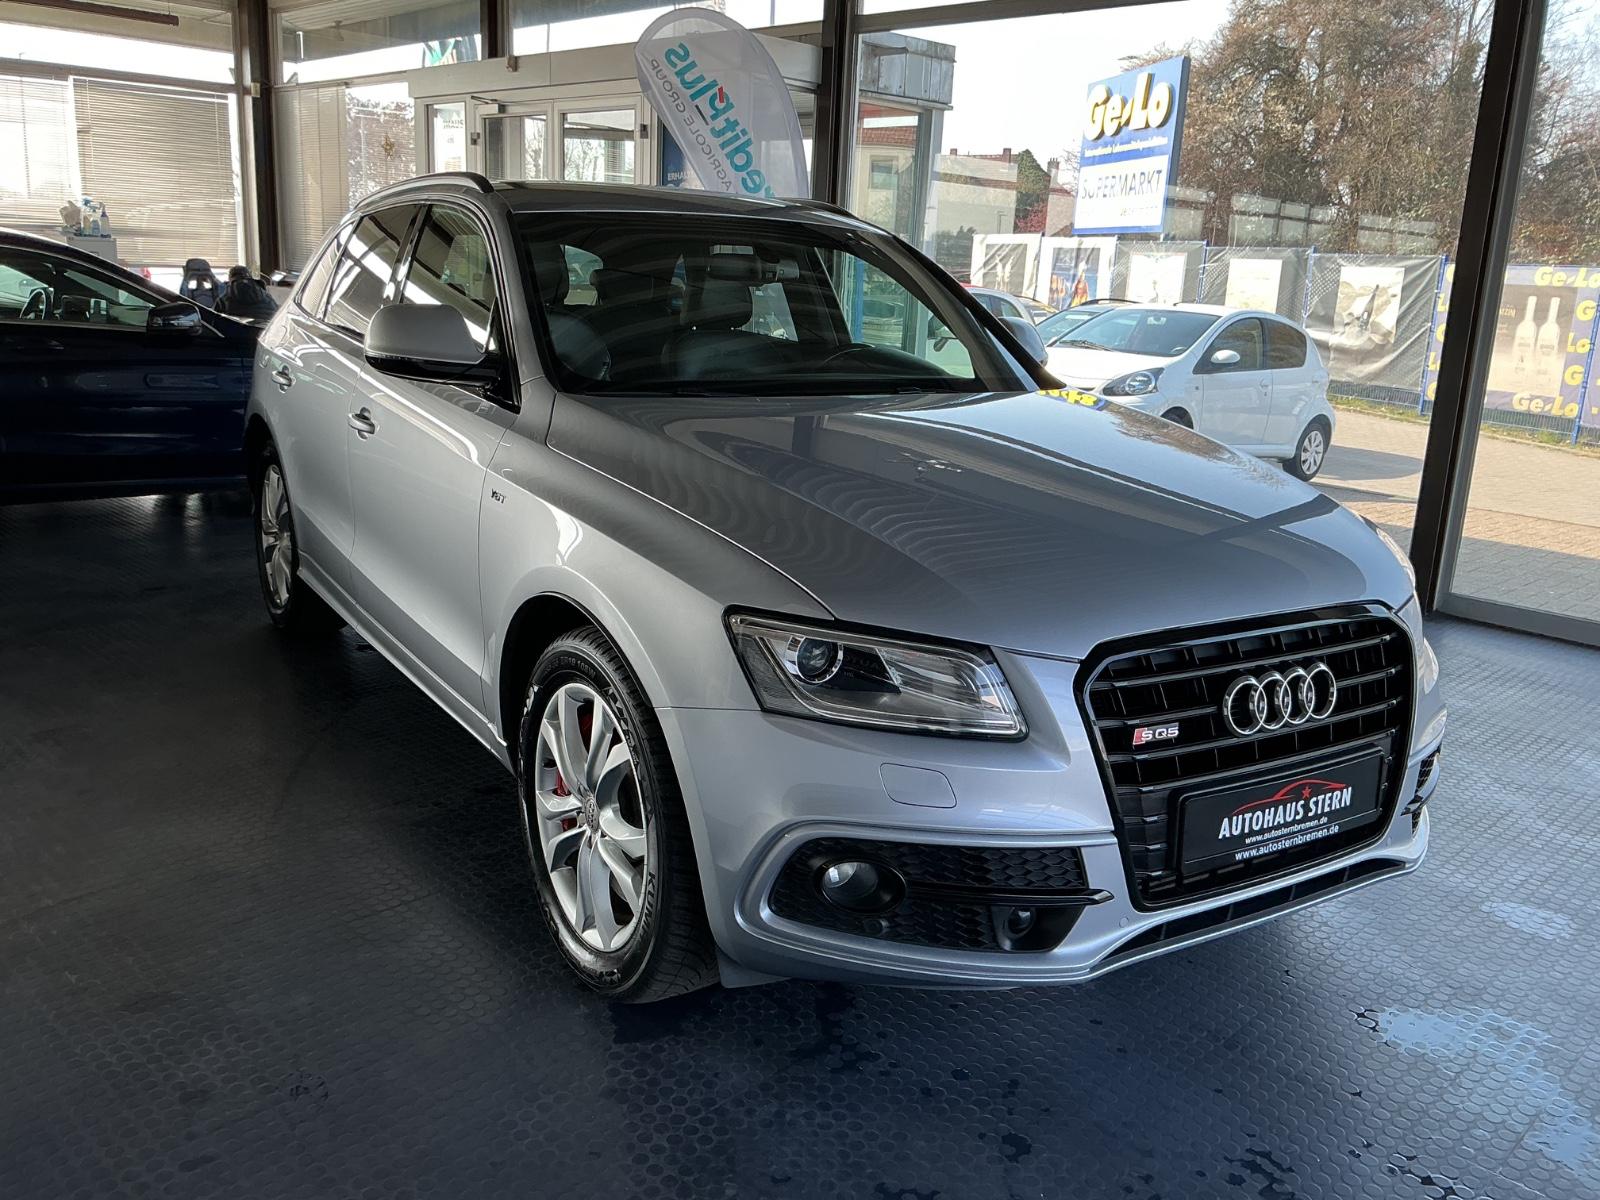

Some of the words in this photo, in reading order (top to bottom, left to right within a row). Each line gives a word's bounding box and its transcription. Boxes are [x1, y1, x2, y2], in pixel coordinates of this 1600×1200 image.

[1081, 169, 1162, 199] SUPERMARKT
[1219, 800, 1305, 839] AUTOHAUS
[1308, 787, 1352, 817] STERN
[1235, 825, 1339, 861] www.autosternbremen.de
[1245, 816, 1328, 845] www.autosternbremen.de
